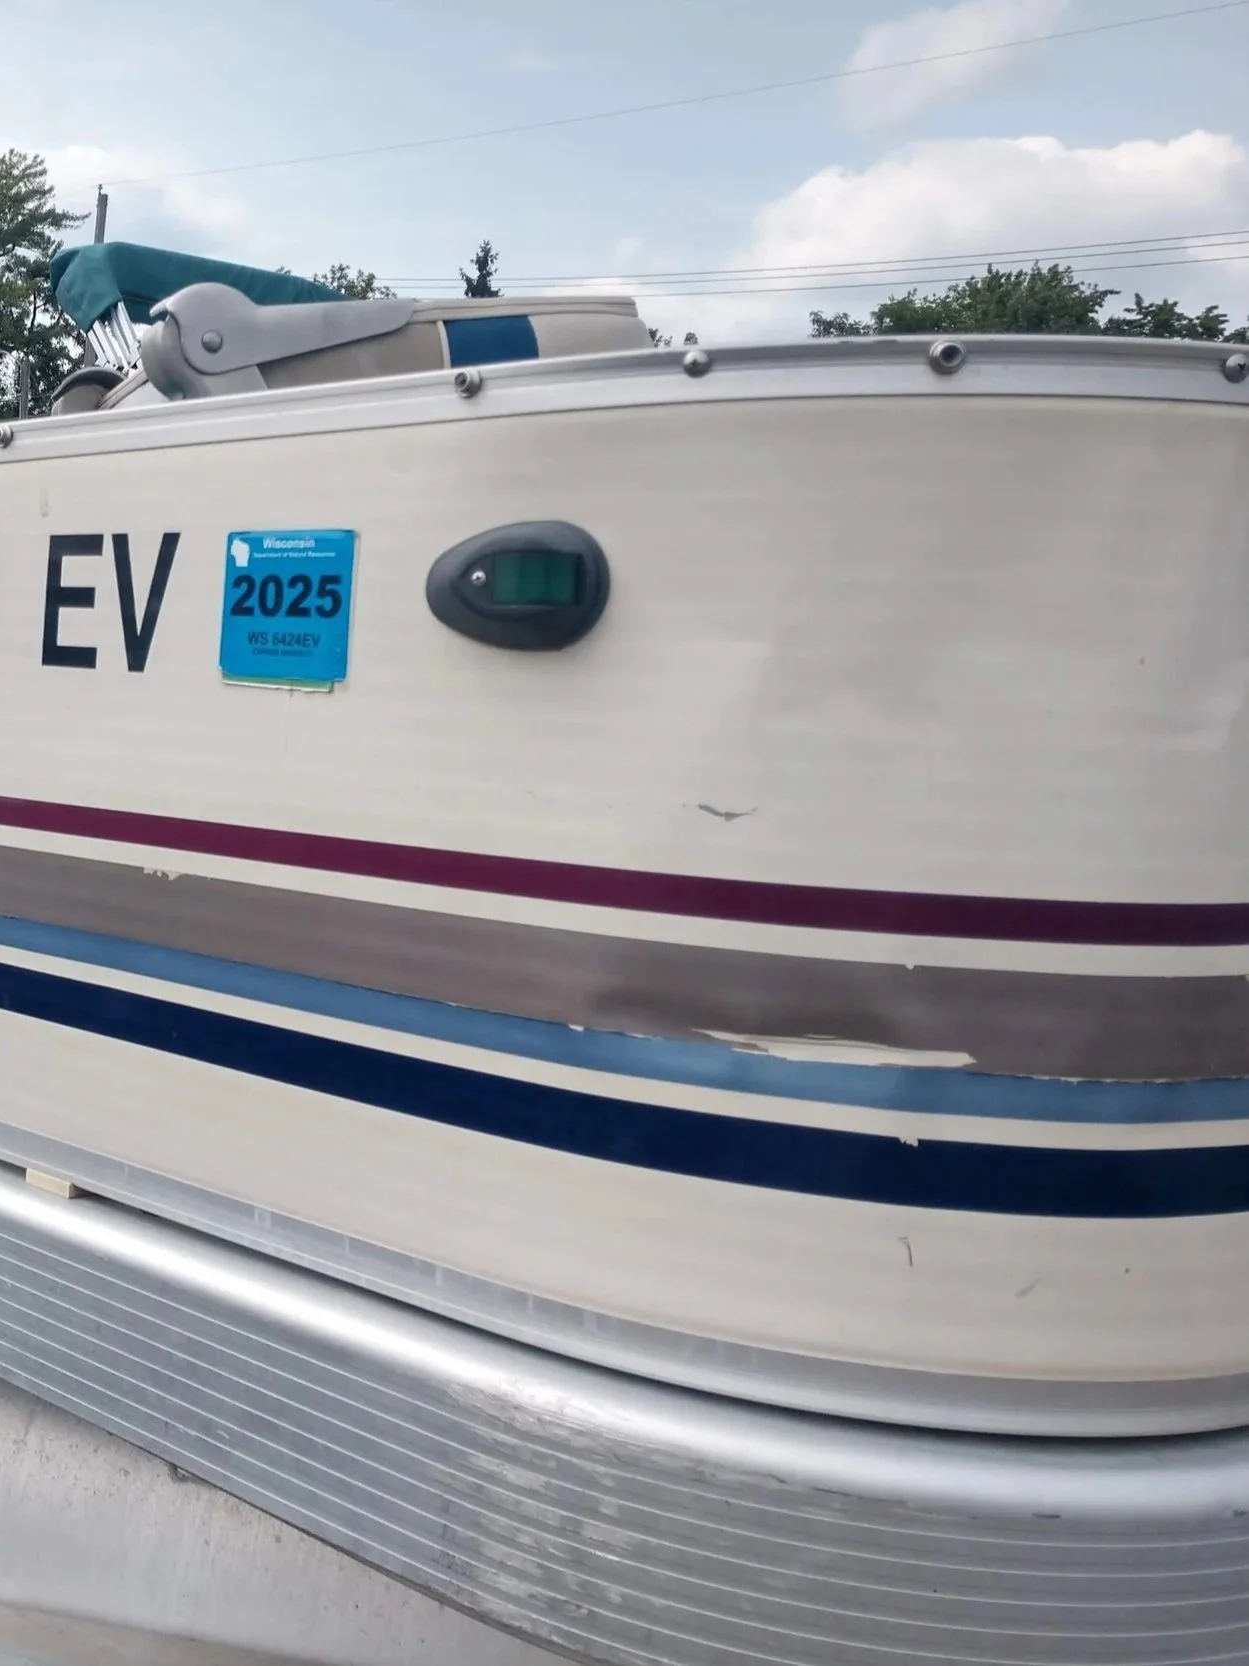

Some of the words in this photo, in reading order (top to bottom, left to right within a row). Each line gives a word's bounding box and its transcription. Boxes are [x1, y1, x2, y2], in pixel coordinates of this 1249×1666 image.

[263, 536, 316, 549] Wisconsin
[41, 532, 181, 673] EV
[230, 573, 343, 619] 2025
[247, 631, 268, 646] WS
